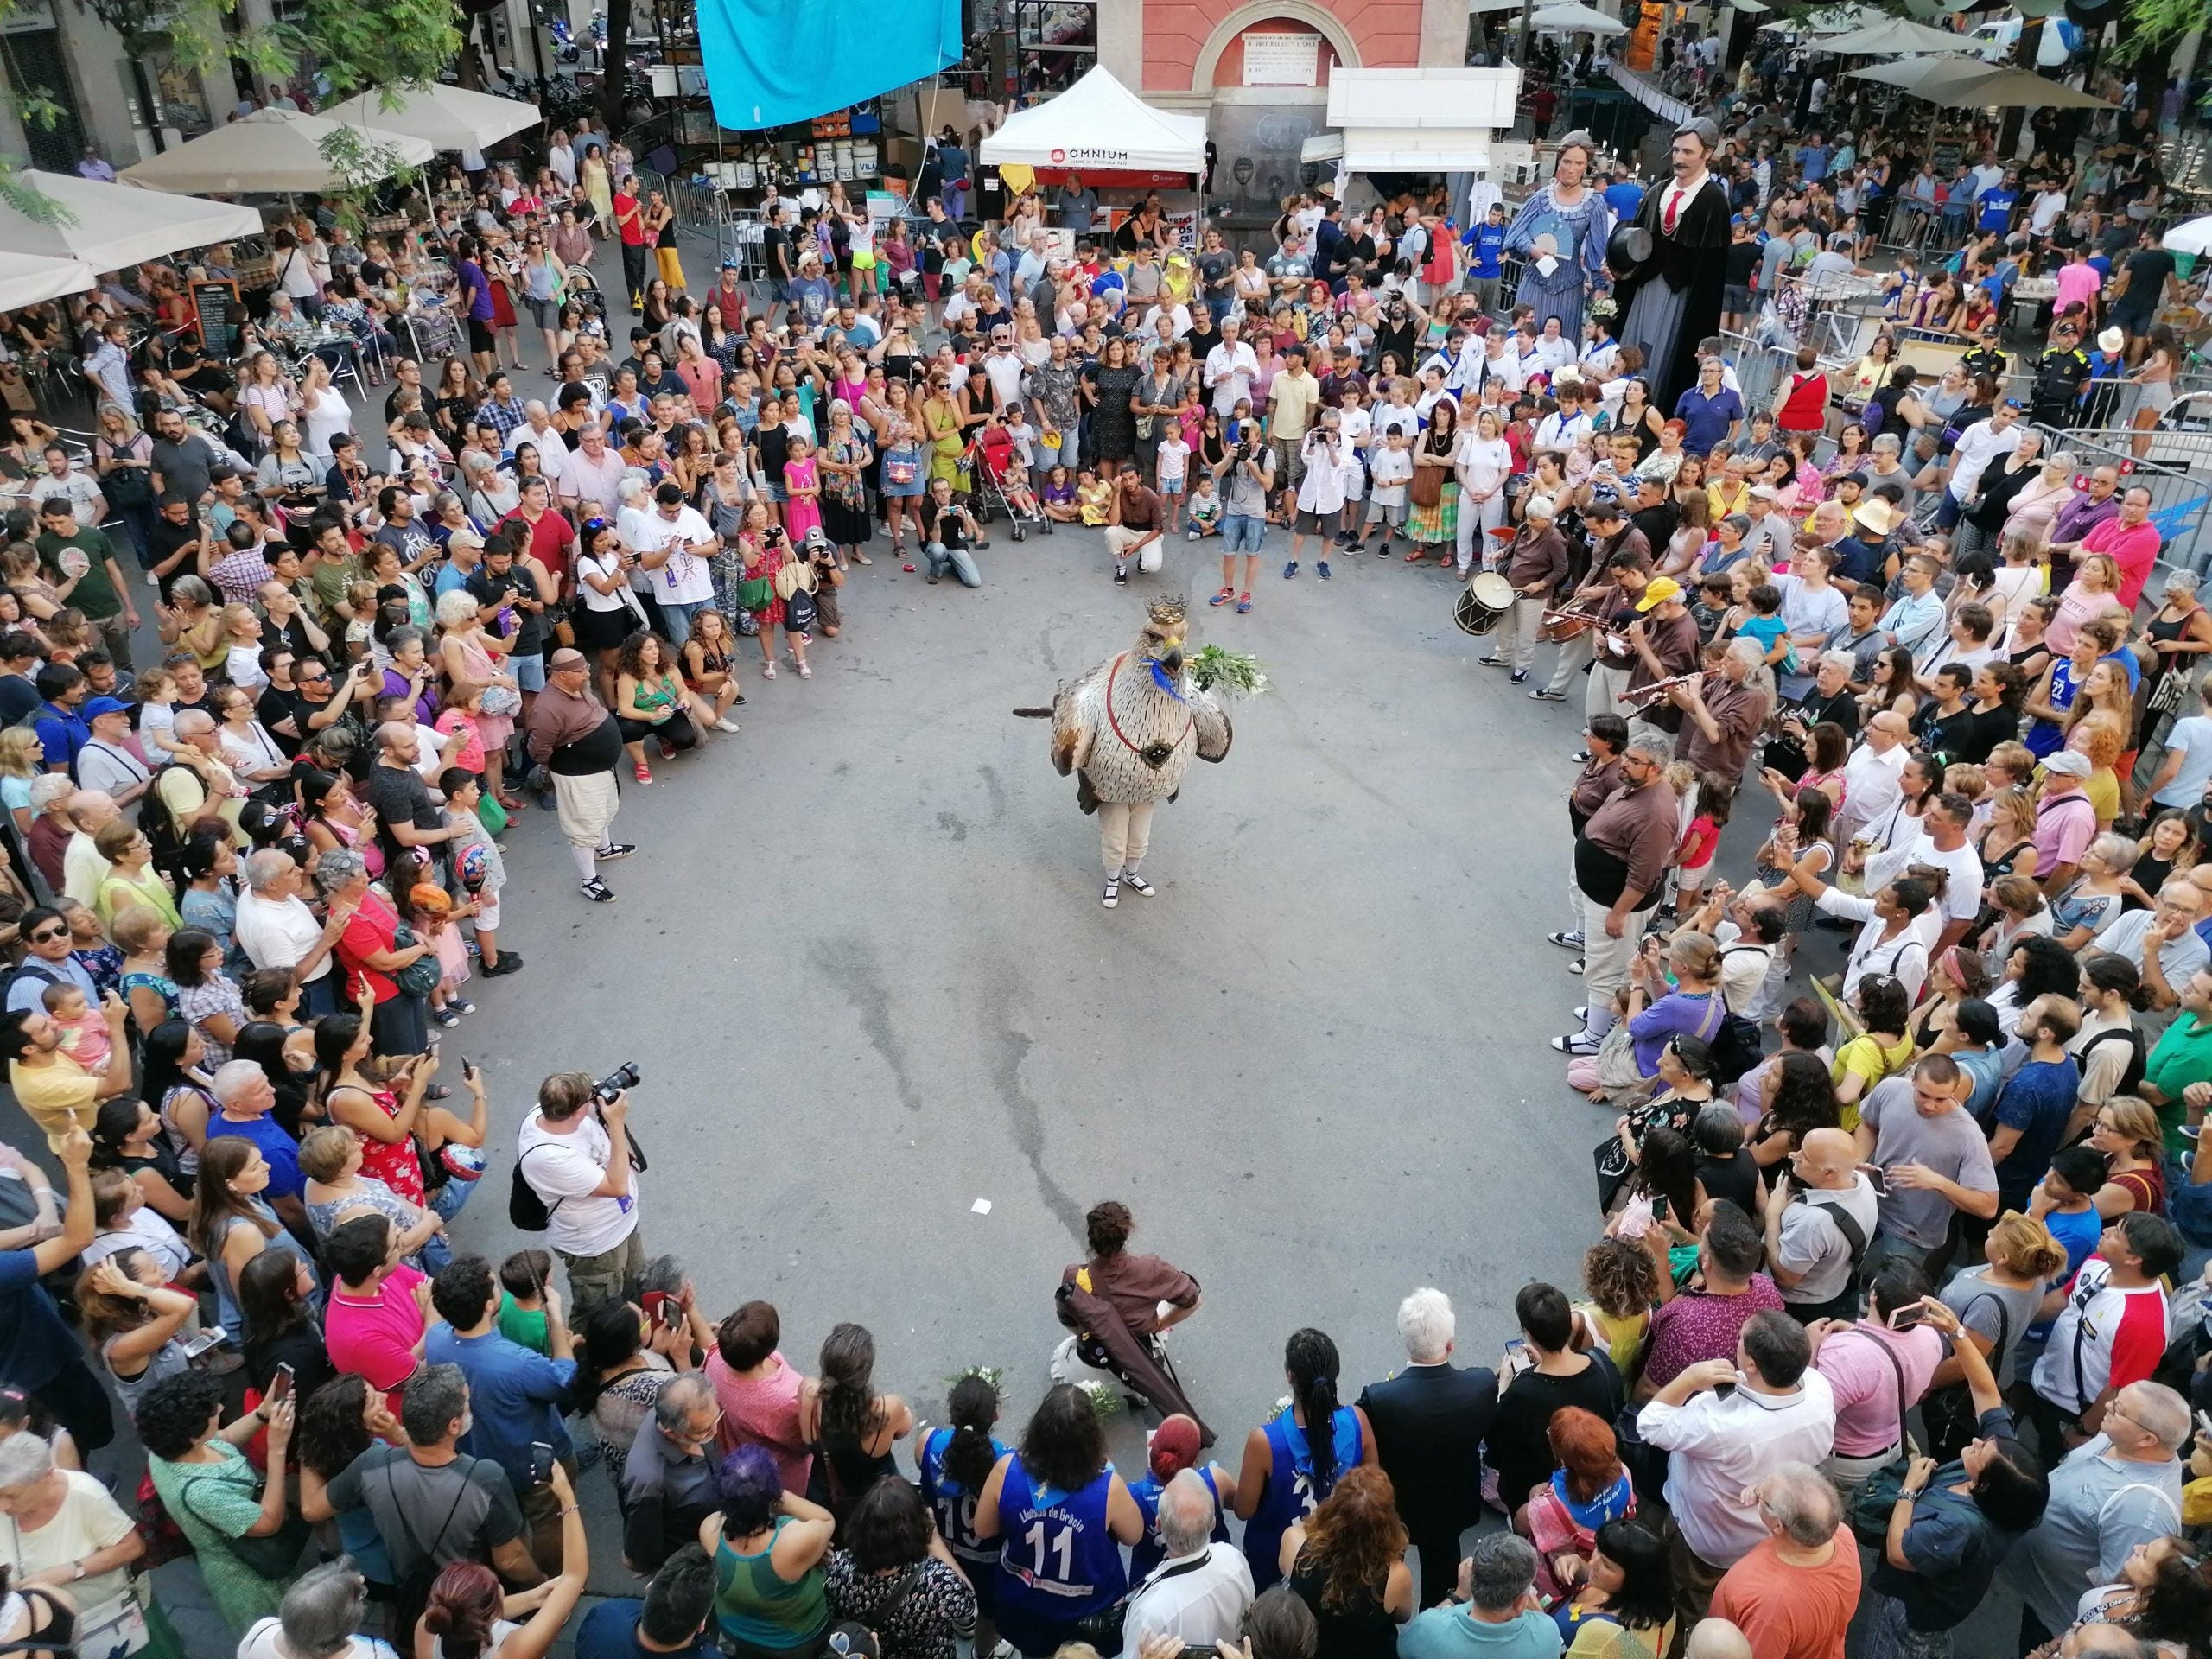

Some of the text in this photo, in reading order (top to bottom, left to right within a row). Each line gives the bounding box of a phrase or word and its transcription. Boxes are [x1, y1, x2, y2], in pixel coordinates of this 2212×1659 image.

[1070, 149, 1128, 160] OMNIUM
[2052, 680, 2064, 700] 22
[1049, 1506, 1058, 1519] de
[1025, 1521, 1072, 1581] 11
